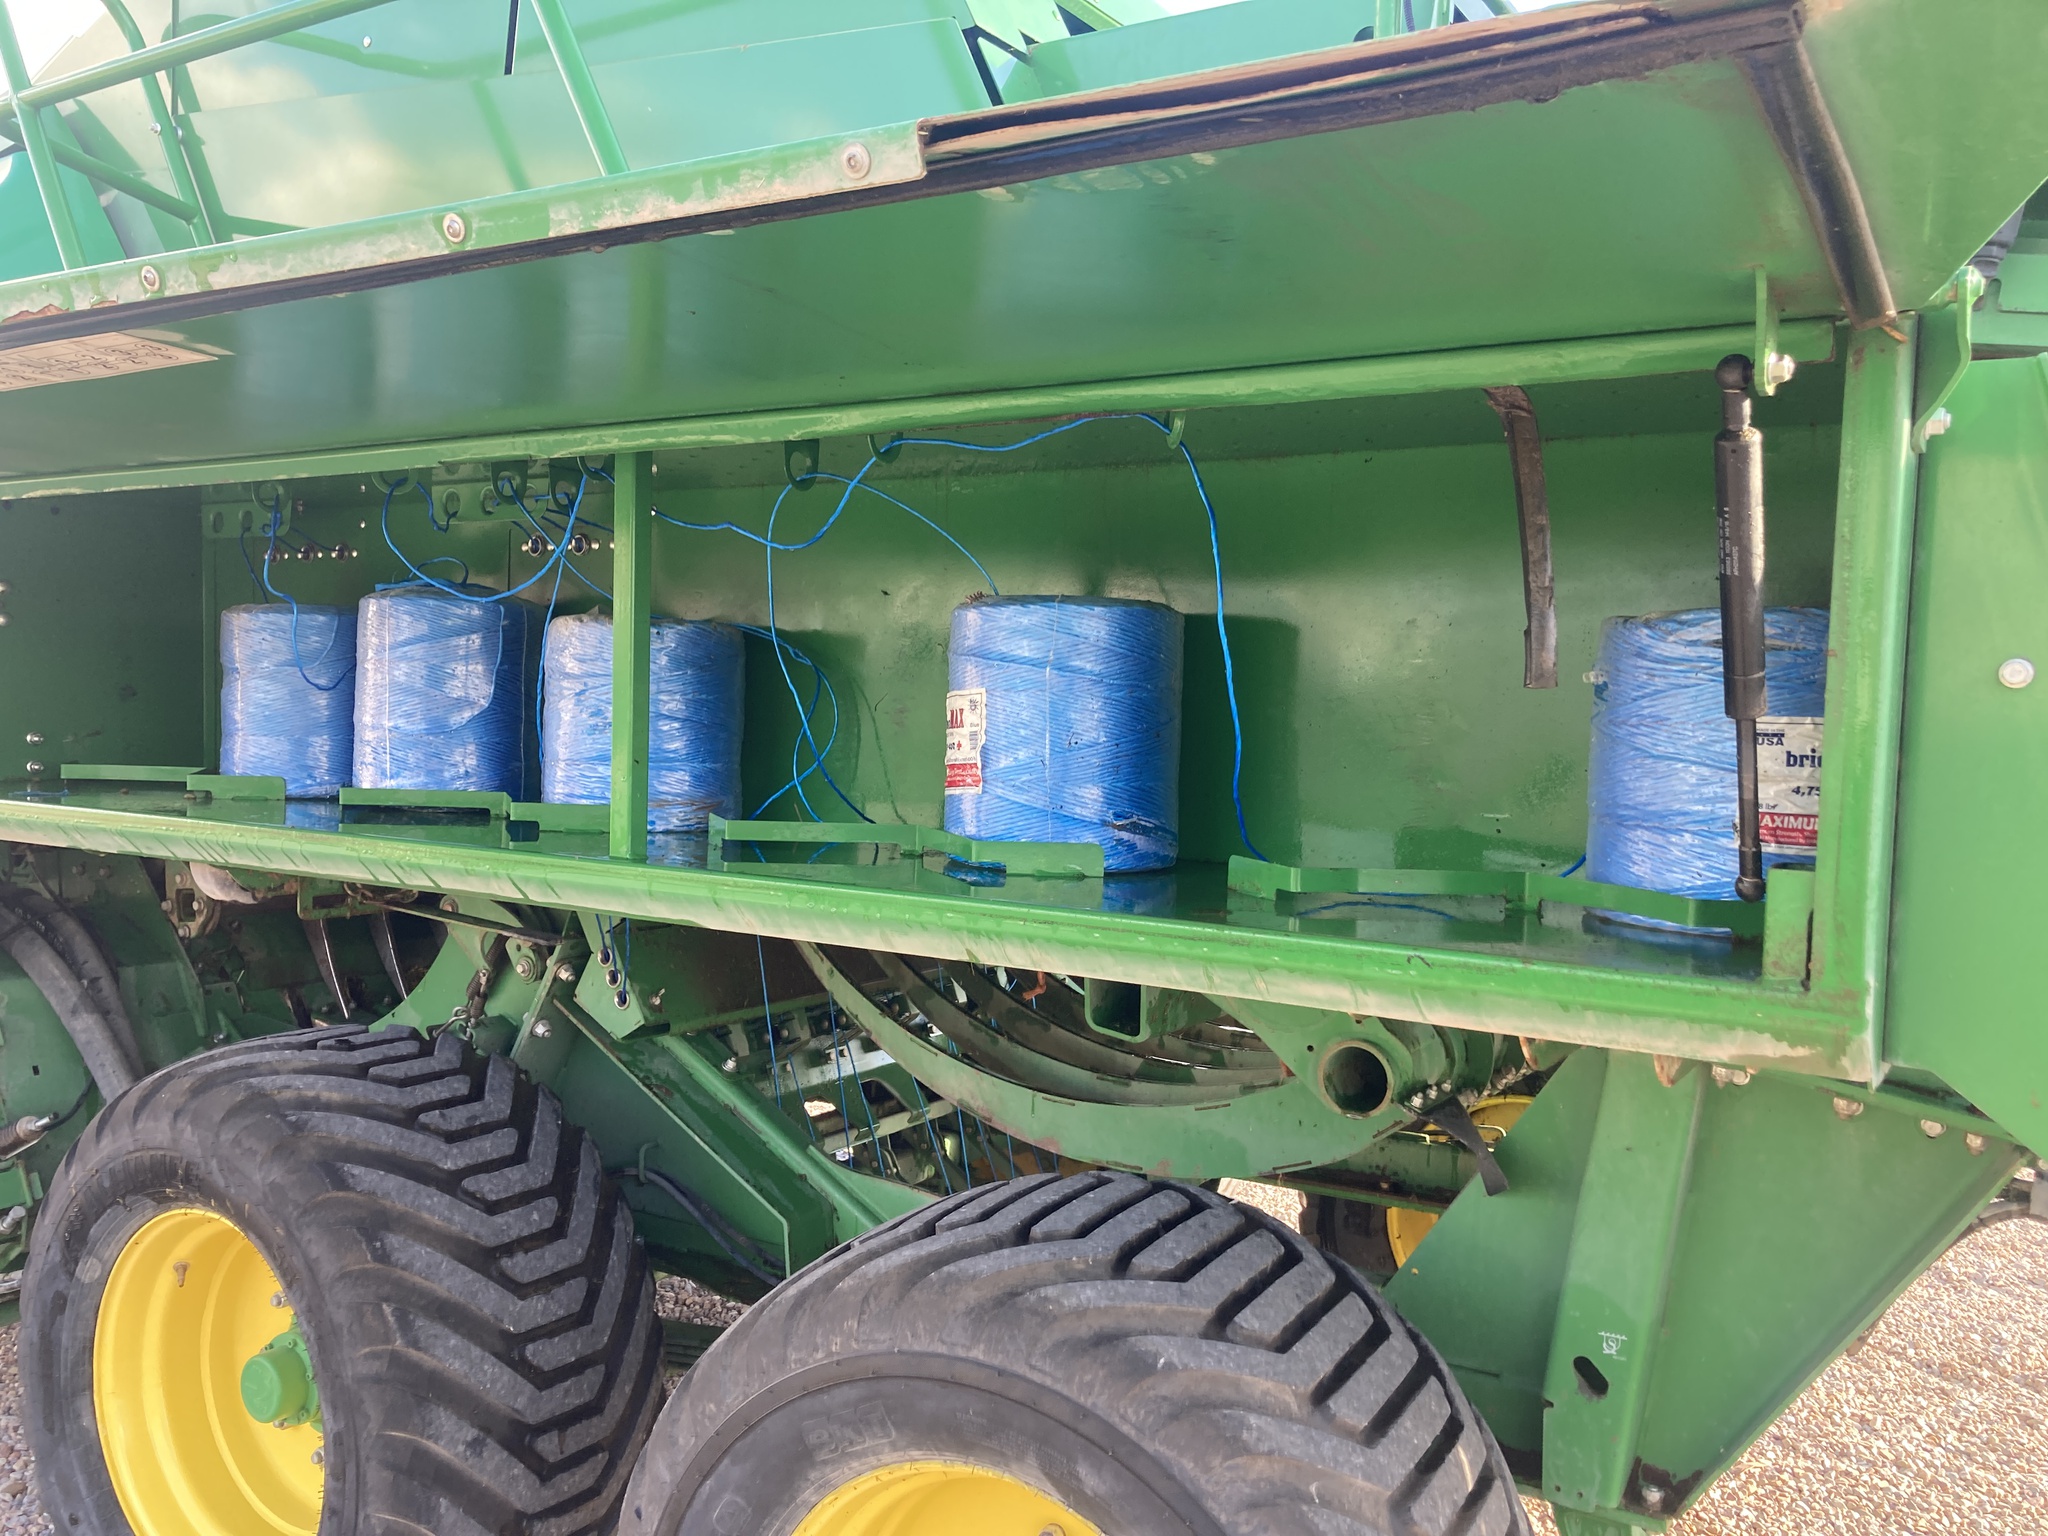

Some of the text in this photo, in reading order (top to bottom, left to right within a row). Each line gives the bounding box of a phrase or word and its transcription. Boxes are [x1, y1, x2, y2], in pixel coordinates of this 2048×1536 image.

[1756, 737, 1784, 746] USA
[1759, 814, 1819, 831] AXIMU
[801, 1400, 895, 1462] BKT
